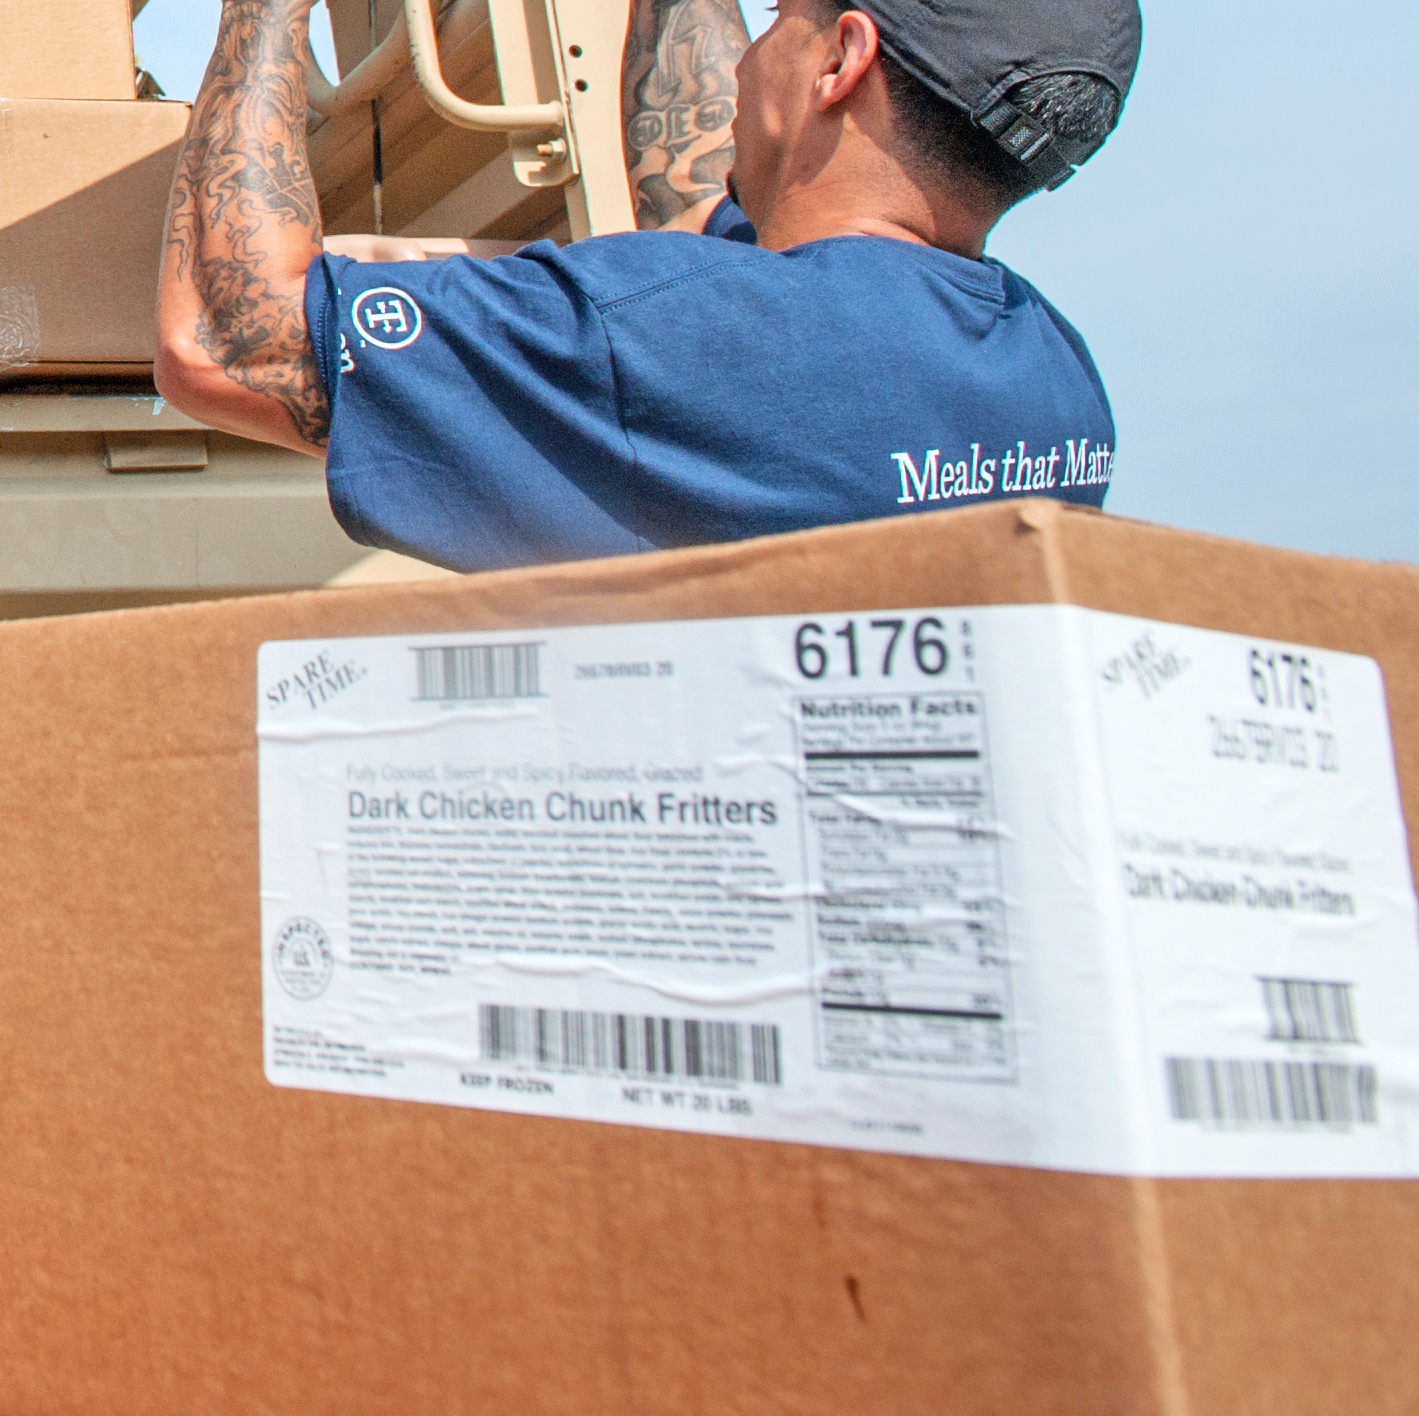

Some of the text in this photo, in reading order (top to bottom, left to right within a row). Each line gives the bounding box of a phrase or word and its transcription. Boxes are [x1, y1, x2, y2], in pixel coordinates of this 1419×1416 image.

[889, 441, 997, 504] Meals
[1001, 440, 1061, 493] that
[793, 616, 950, 681] 6176
[266, 649, 337, 711] SPARE
[1247, 647, 1317, 714] 6176
[801, 696, 977, 718] Nutrition Facts
[348, 790, 780, 827] Dark Chicken Chunk Fritters
[460, 1072, 492, 1089] KEEP
[496, 1076, 556, 1096] FROZEN
[621, 1087, 657, 1107] NET
[661, 1091, 691, 1111] WT
[693, 1094, 715, 1112] 20
